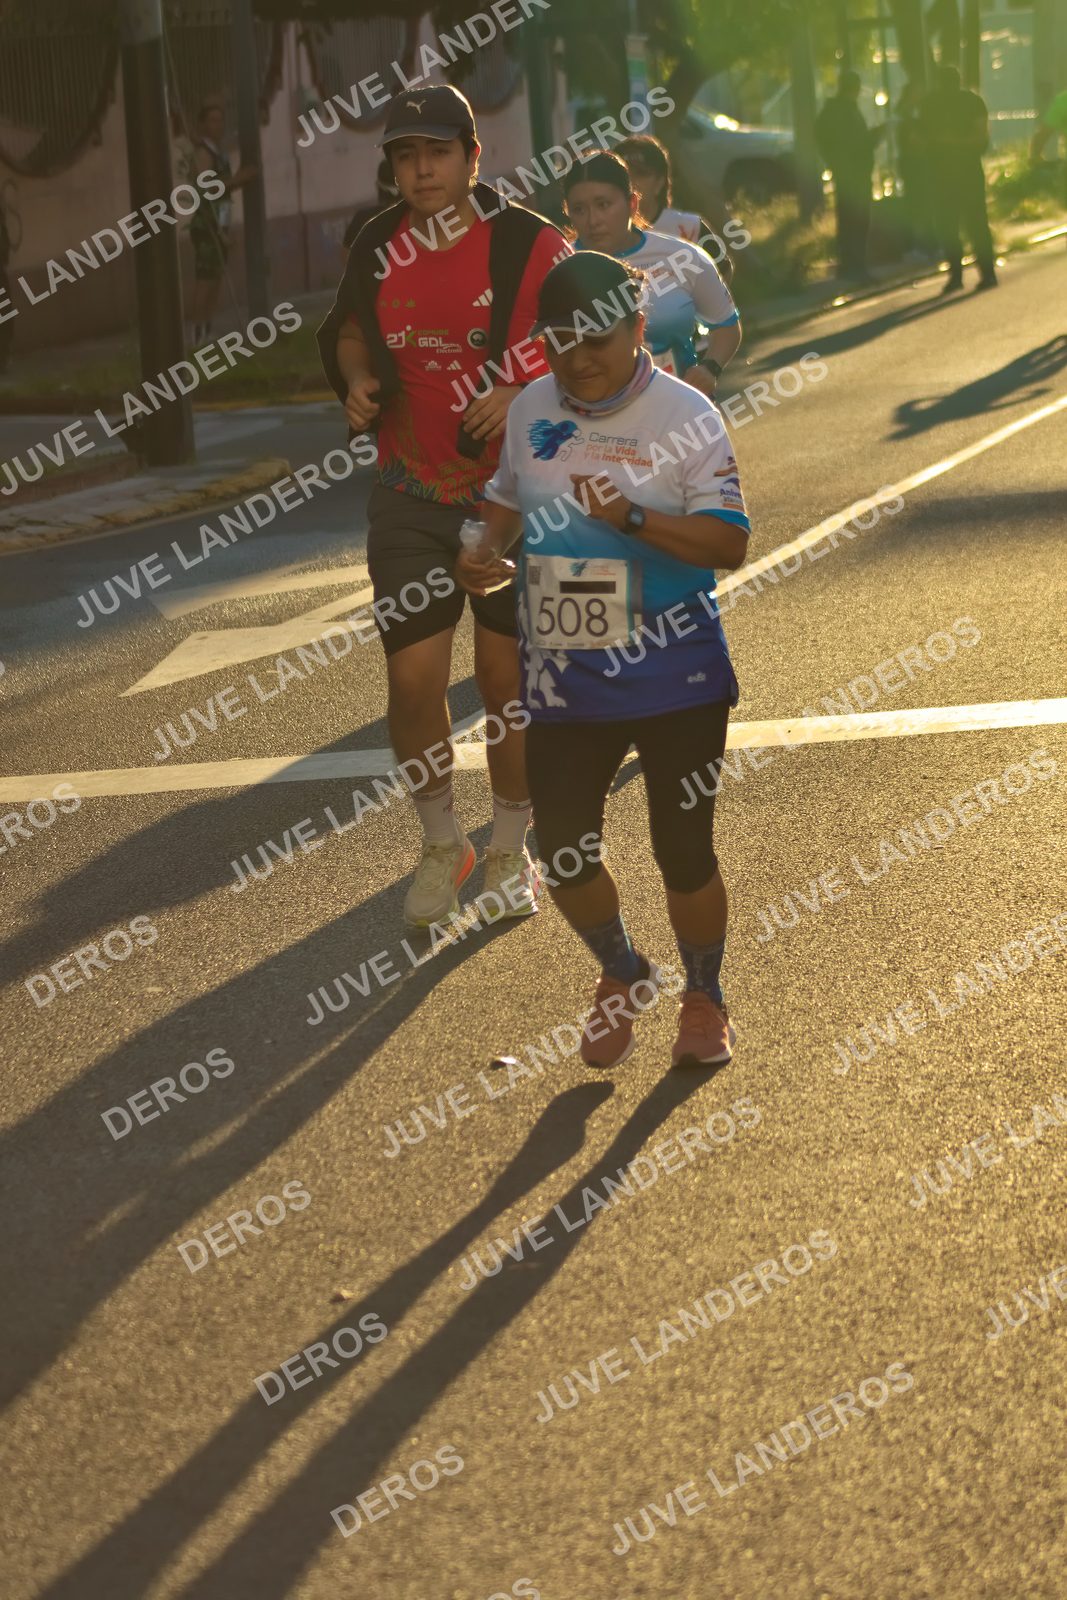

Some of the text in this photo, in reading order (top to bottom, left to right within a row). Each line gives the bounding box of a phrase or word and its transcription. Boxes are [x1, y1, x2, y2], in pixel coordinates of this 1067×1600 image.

[418, 336, 446, 347] GDL
[589, 432, 638, 446] Carrera
[586, 444, 601, 452] por
[616, 447, 636, 456] Vida
[536, 596, 608, 637] 508
